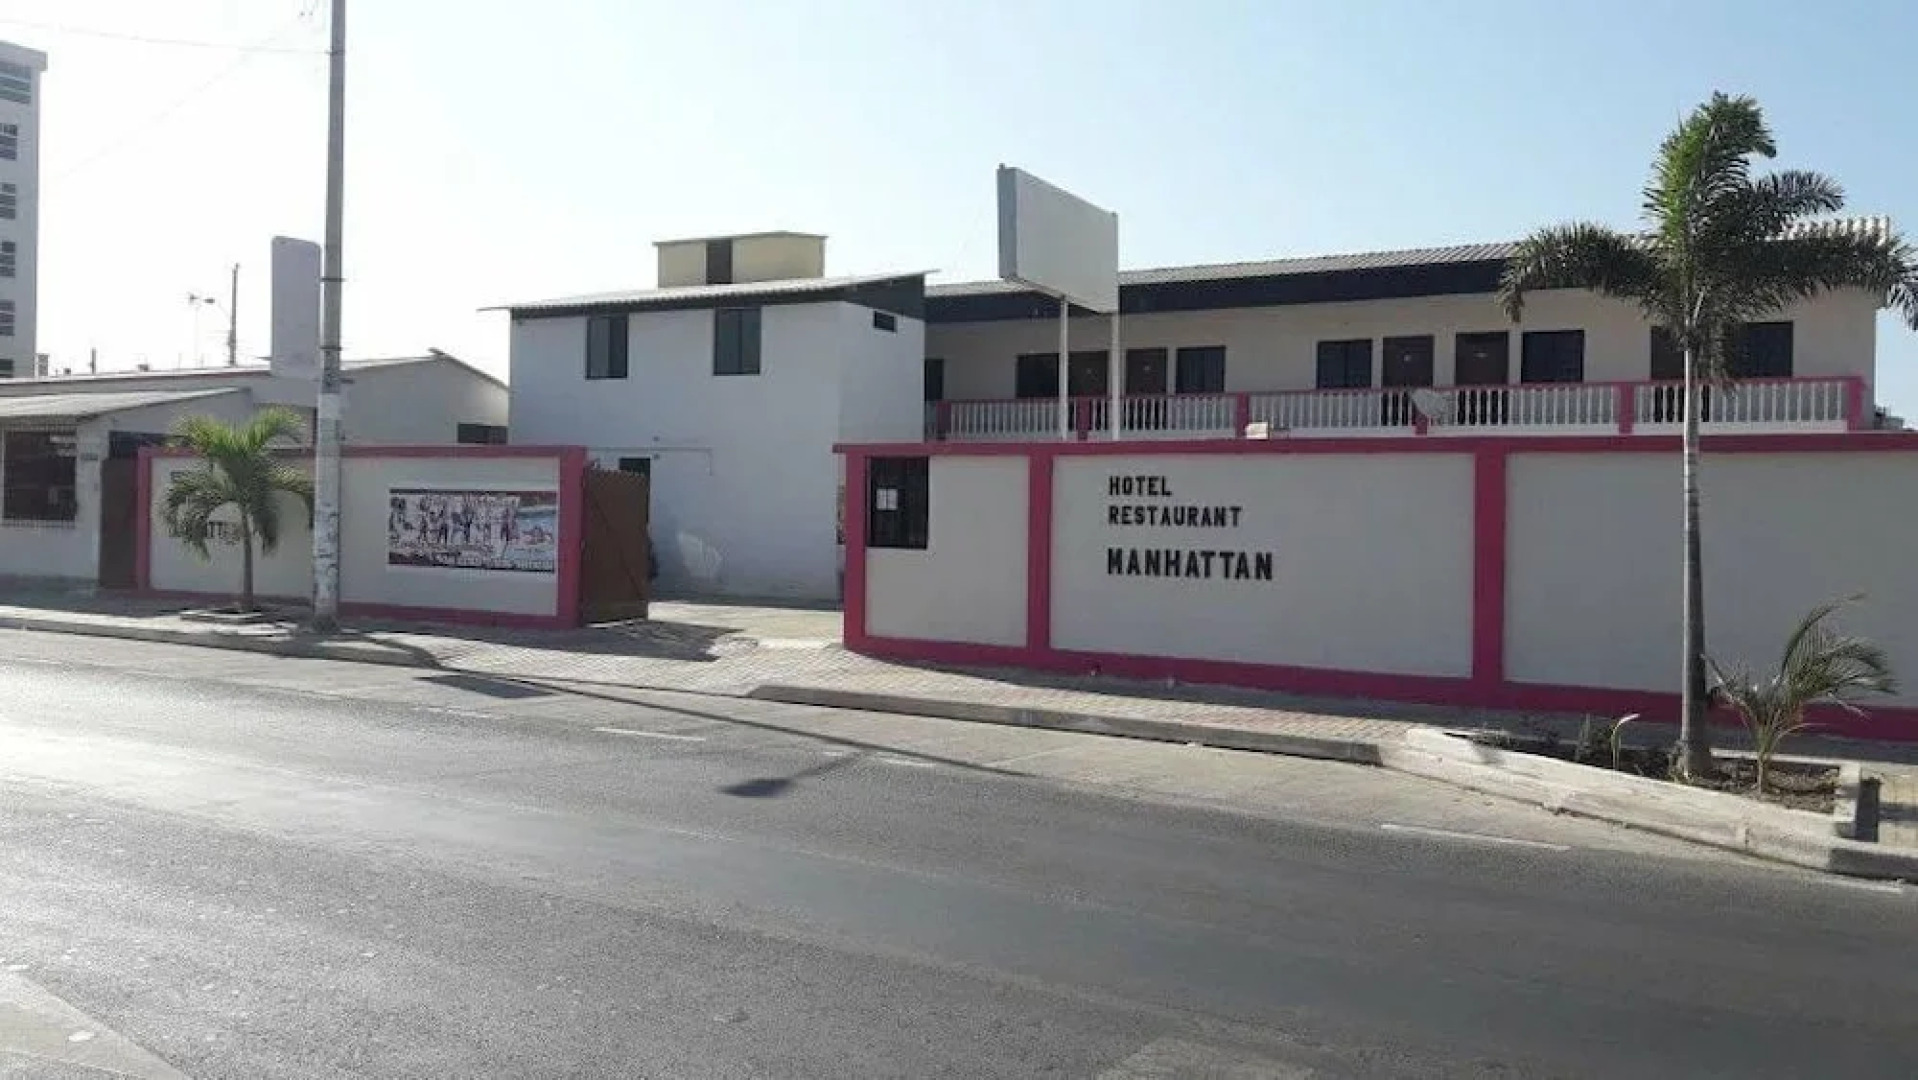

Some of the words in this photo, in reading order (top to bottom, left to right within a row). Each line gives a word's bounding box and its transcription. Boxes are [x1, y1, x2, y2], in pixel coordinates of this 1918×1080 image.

[1108, 475, 1173, 497] HOTEL
[1108, 505, 1243, 528] RESTAURANT
[1107, 547, 1274, 581] MANHATTAN
